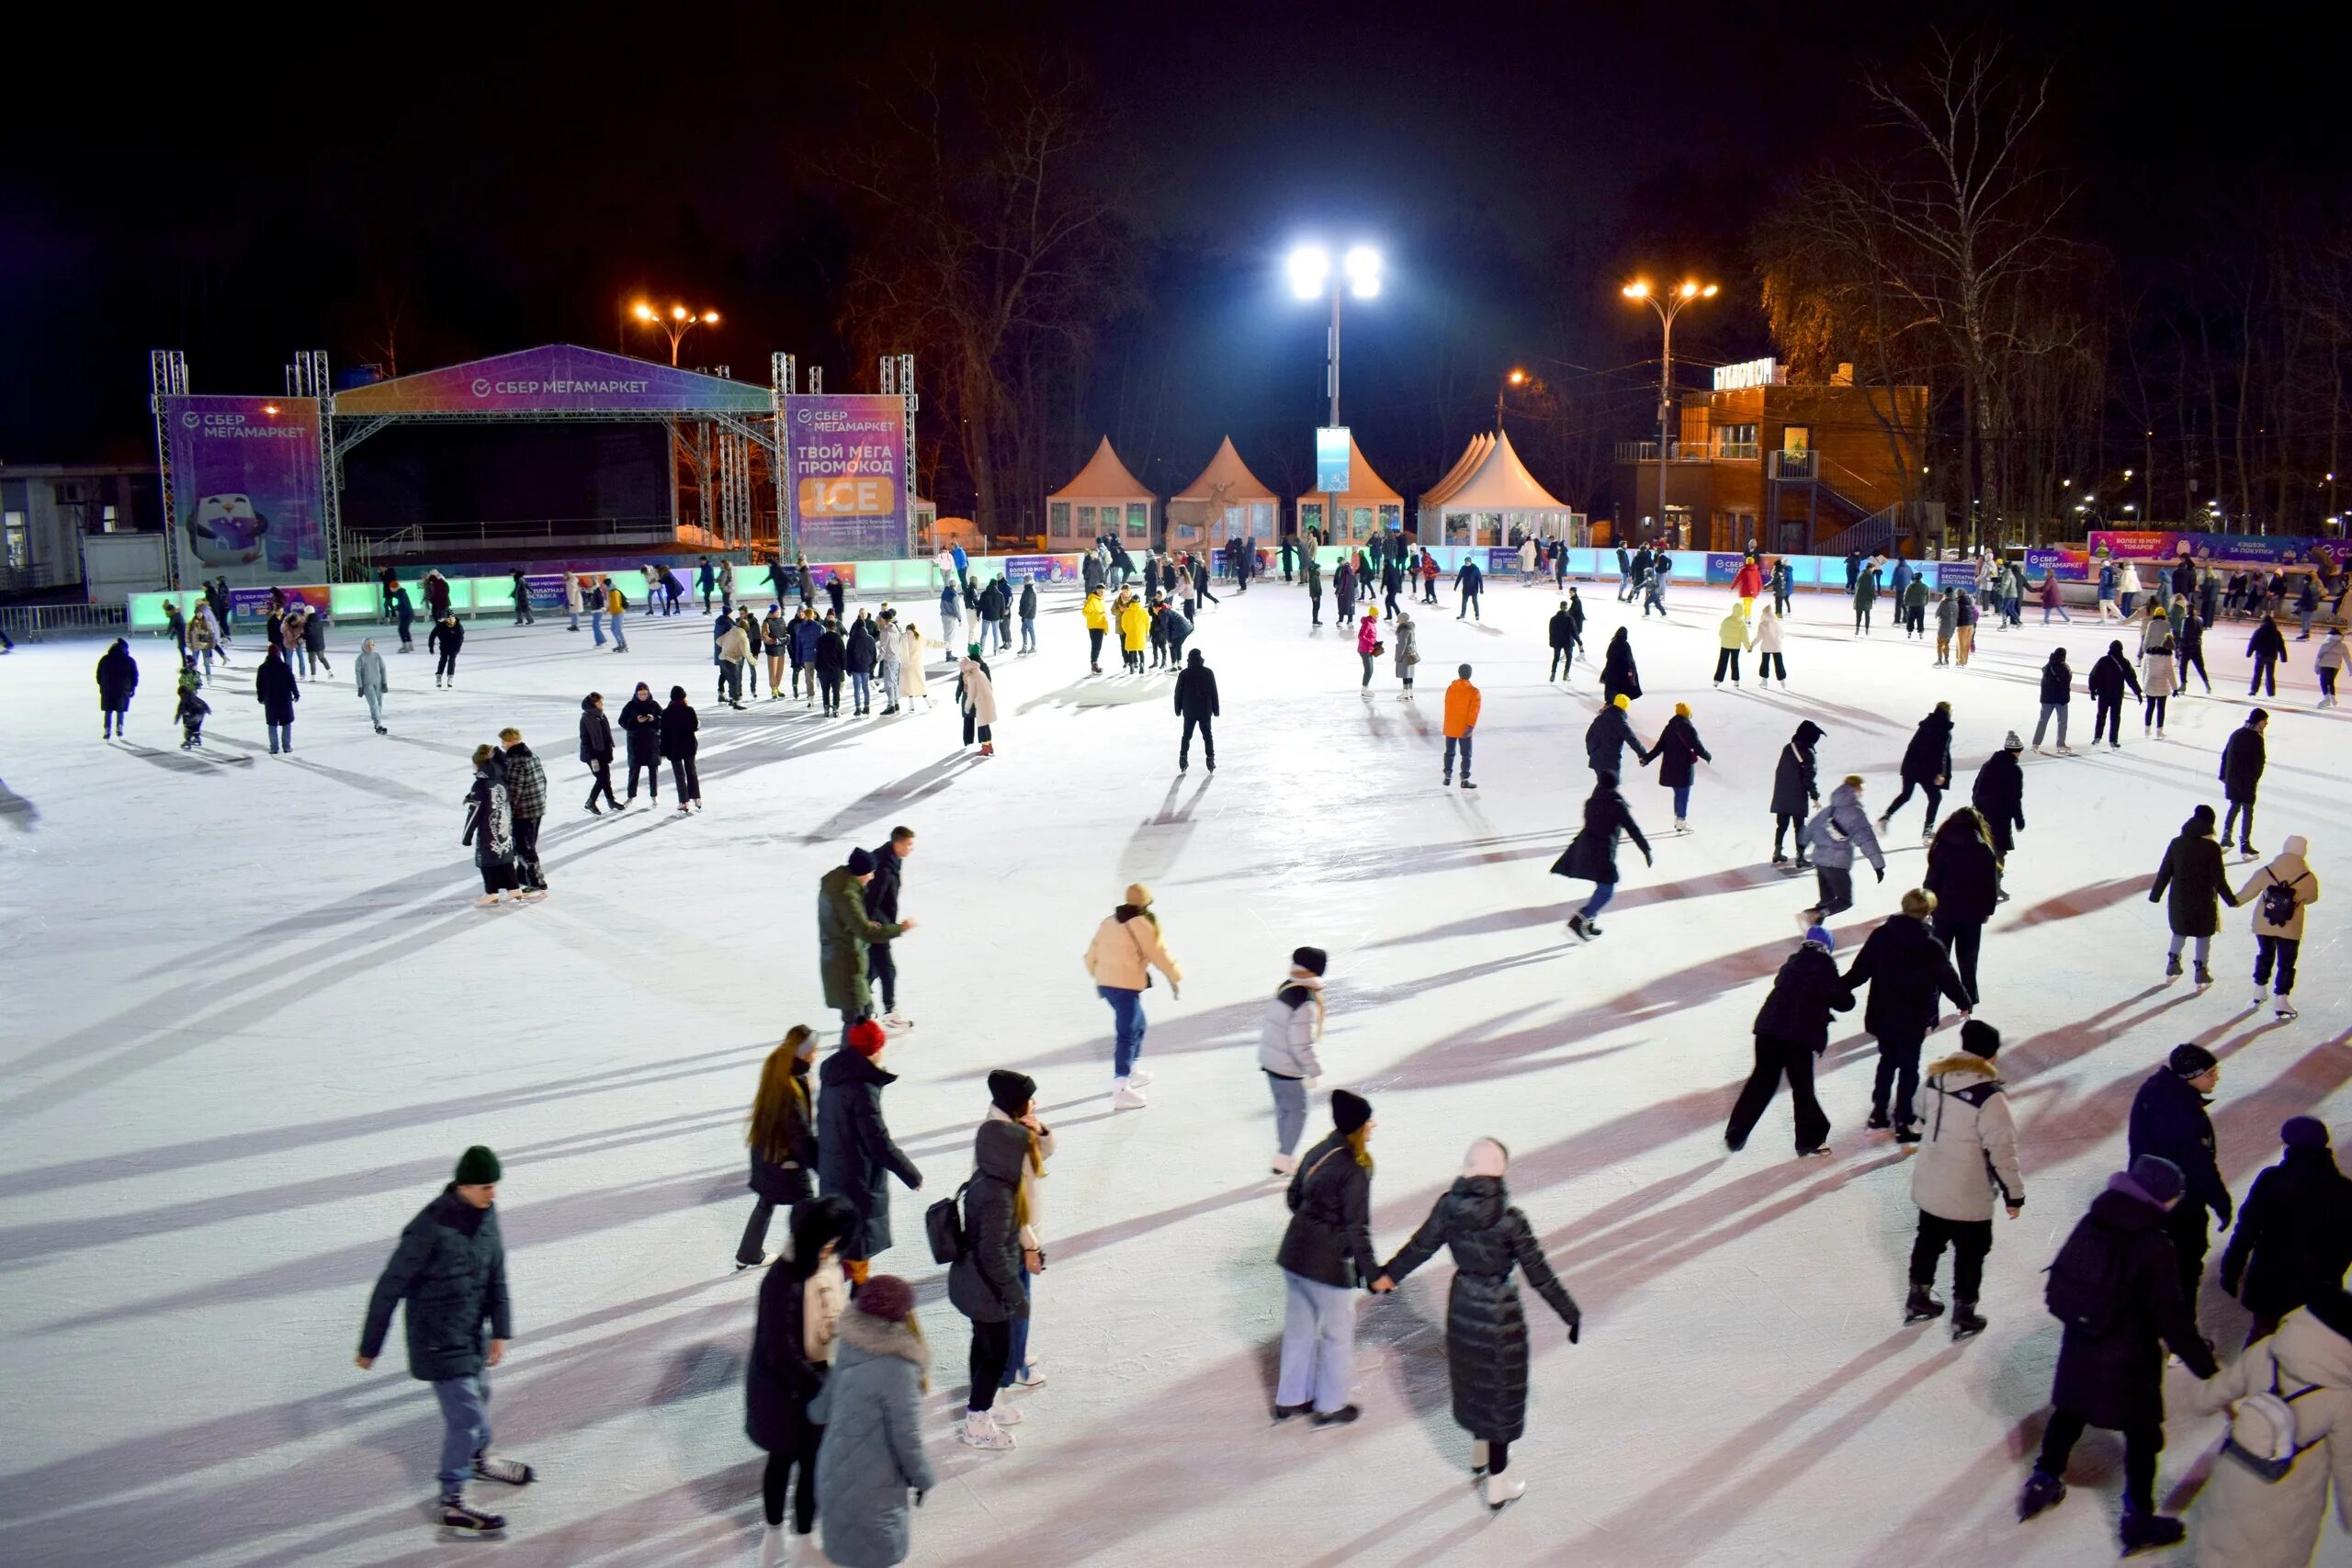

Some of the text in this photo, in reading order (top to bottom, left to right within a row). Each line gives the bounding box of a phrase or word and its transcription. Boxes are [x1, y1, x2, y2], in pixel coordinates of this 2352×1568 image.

[495, 381, 649, 394] СБЕР МЕГАМАРКЕТ
[204, 414, 246, 425] СБЕР
[815, 411, 848, 421] СБЕР
[204, 426, 307, 438] МЕГАМАРКЕТ
[814, 422, 896, 432] МЕГАМАРКЕТ
[797, 443, 893, 458] ТВОЙ МЕГА
[798, 460, 894, 474] ПРОМОКОД
[814, 481, 879, 512] ICE
